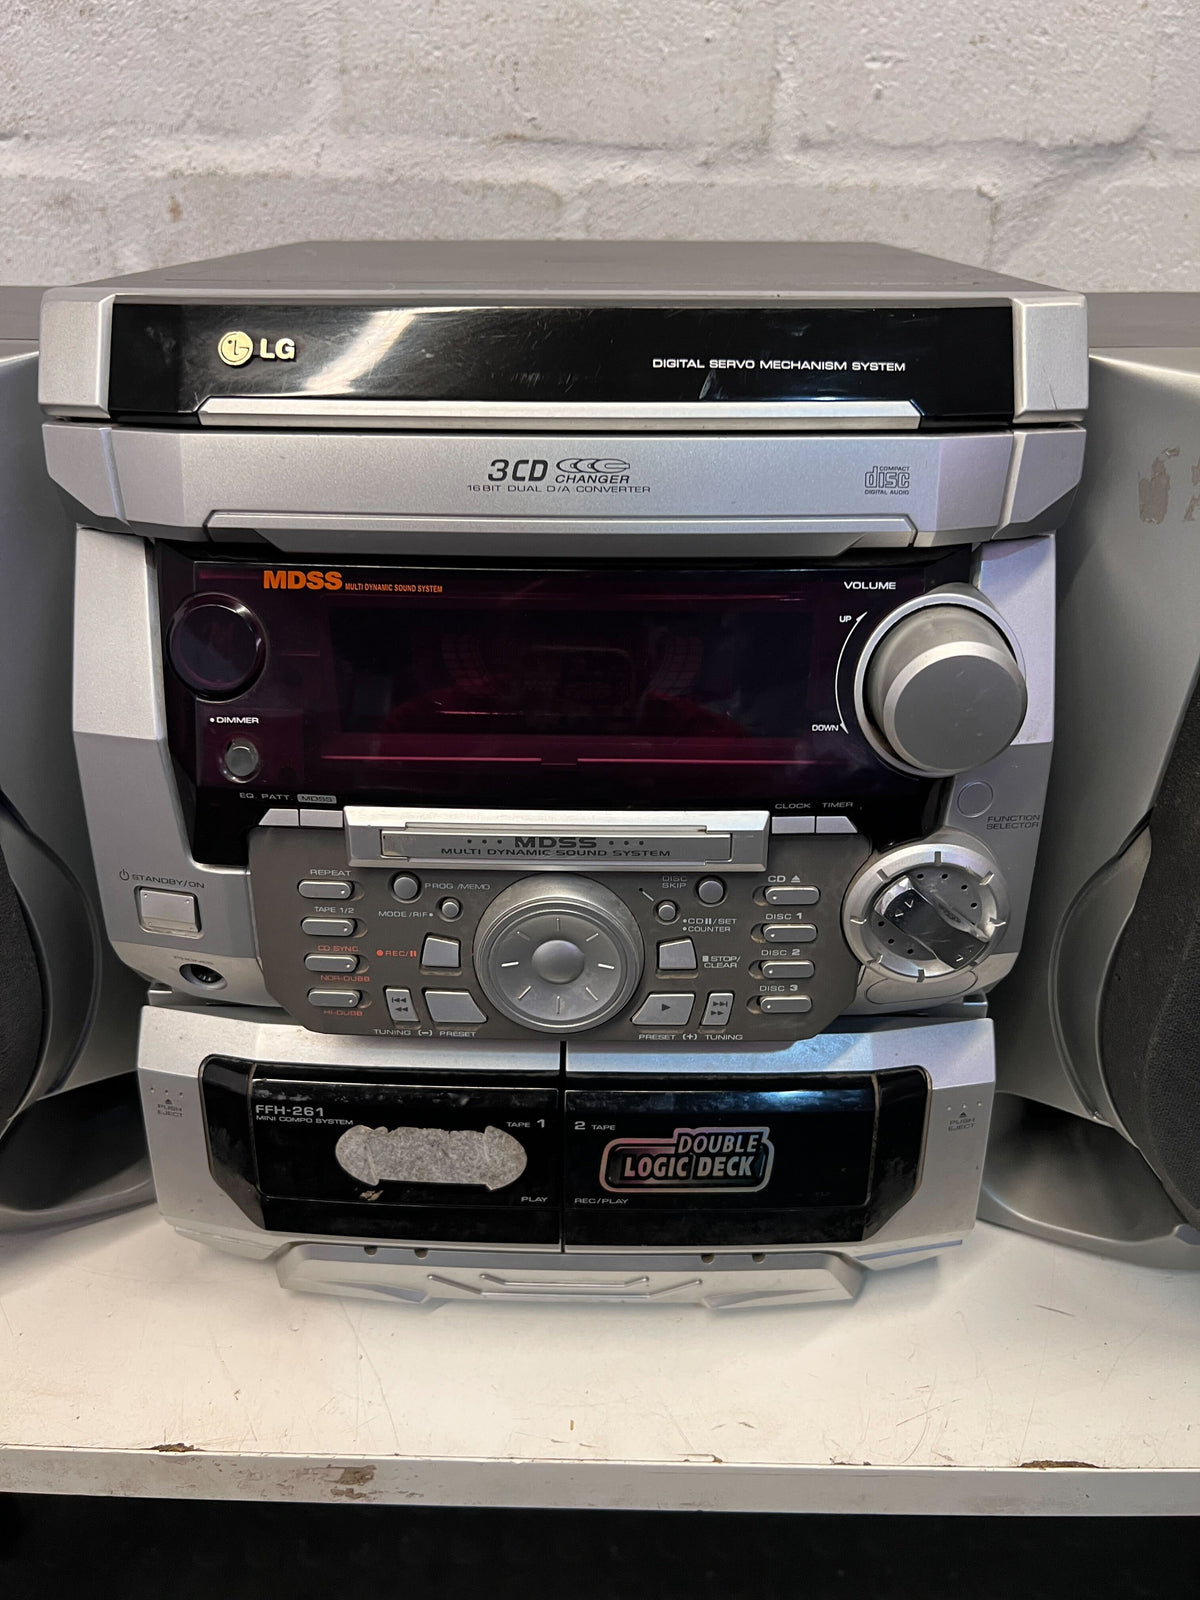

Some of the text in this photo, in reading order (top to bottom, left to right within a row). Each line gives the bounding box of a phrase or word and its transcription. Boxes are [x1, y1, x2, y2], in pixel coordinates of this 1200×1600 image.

[260, 338, 296, 359] LG
[652, 358, 906, 372] DIGITAL SERVO MECHANISM SYSTEM
[487, 458, 630, 485] 3CD CHANGER
[507, 485, 543, 493] DUAL
[546, 486, 570, 494] D/A
[575, 486, 651, 494] CONVERTER
[263, 570, 443, 593] MDSS MULTI DYNAMIC SOUND SYSTEM
[843, 581, 897, 590] VOLUME
[839, 615, 852, 623] UP
[216, 716, 260, 724] DIMMER
[987, 815, 1041, 823] FUNCTION
[986, 821, 1039, 830] SELECTOR
[514, 837, 597, 849] MDSS
[487, 848, 552, 856] DYNAMIC
[555, 849, 608, 857] SOUND
[310, 869, 351, 877] REPEAT
[132, 873, 205, 889] STANDBY/ON
[767, 875, 786, 883] CD
[796, 912, 803, 920] 1
[791, 948, 801, 956] 2
[789, 984, 798, 992] 3
[373, 1028, 412, 1036] TUNING
[255, 1104, 324, 1117] FFH-261
[536, 1119, 546, 1128] 1
[574, 1121, 586, 1130] 2
[677, 1134, 760, 1154] DOUBLE
[623, 1155, 755, 1177] LOGIC DECK
[574, 1197, 629, 1205] REC/PLAY
